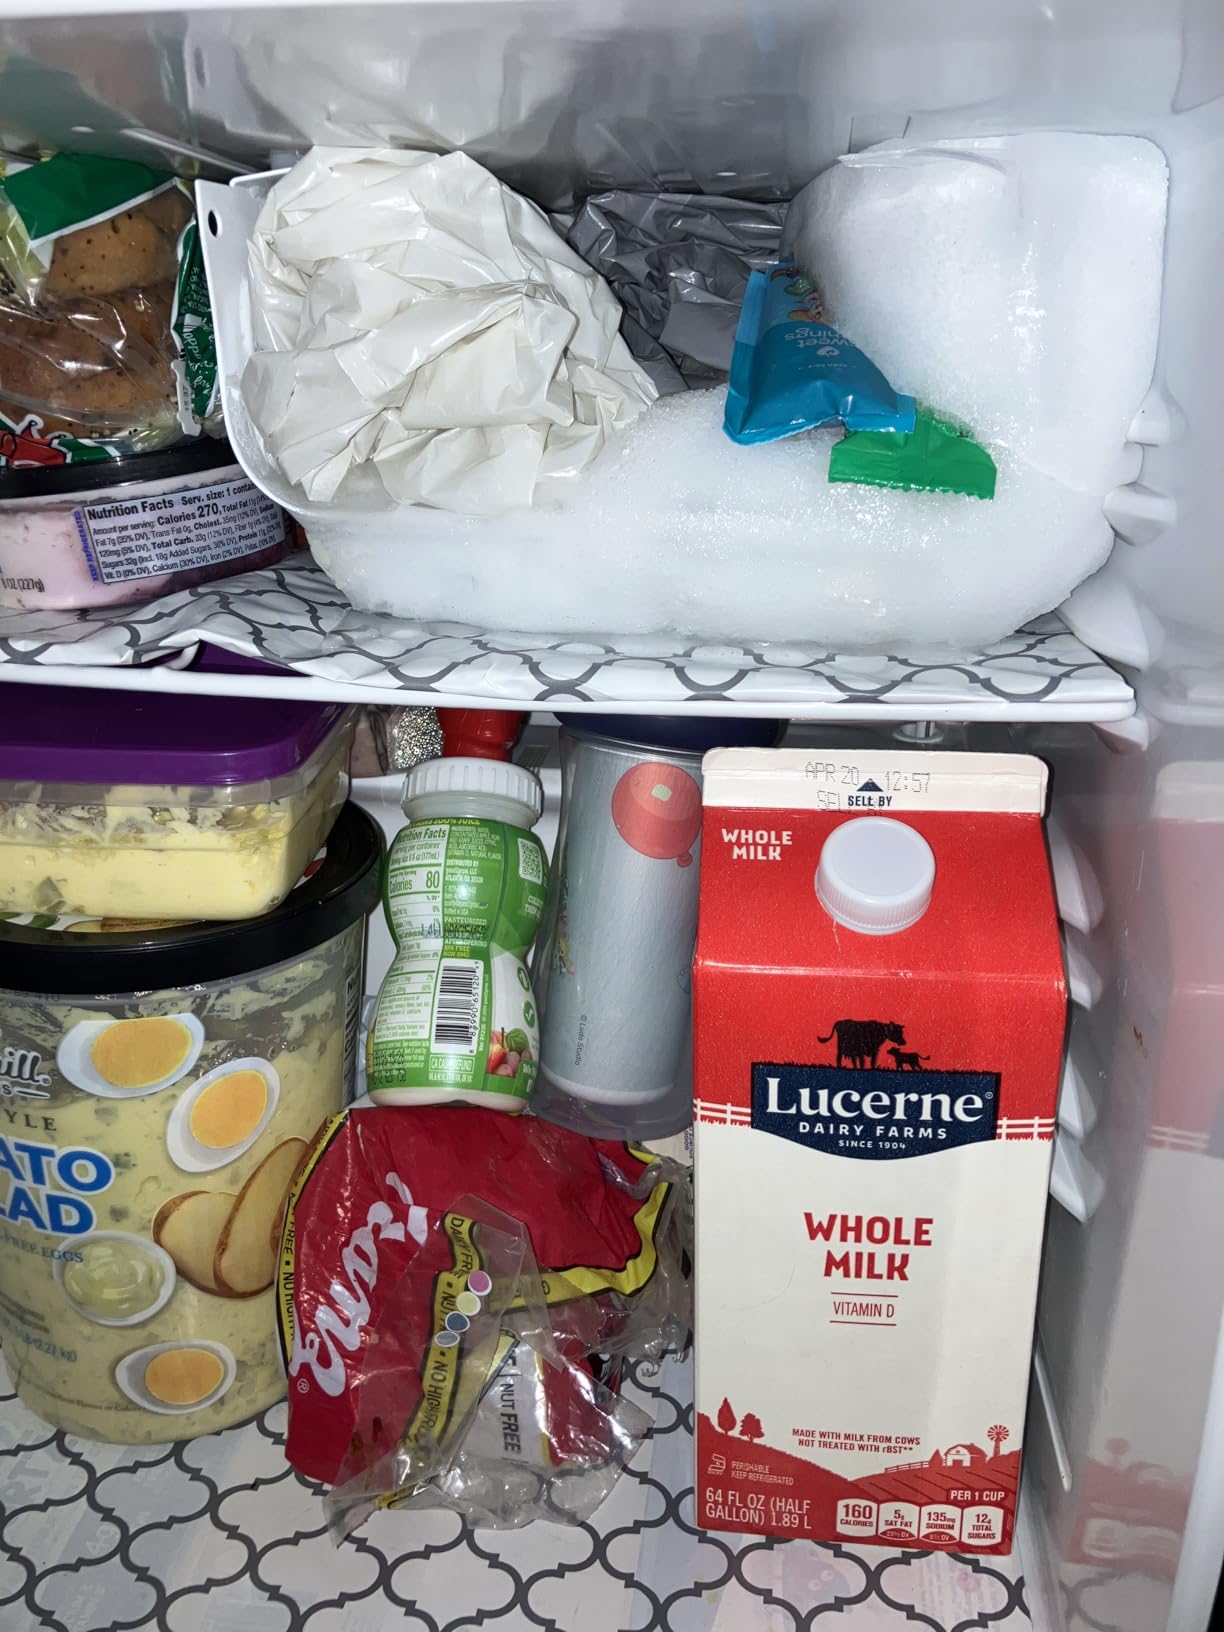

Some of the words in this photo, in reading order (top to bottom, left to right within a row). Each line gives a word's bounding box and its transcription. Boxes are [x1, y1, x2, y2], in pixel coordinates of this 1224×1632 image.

[784, 326, 840, 341] hings
[797, 338, 849, 348] weet
[87, 504, 138, 521] Nutrition
[141, 498, 174, 513] Facts
[181, 495, 204, 506] Serv.
[206, 489, 225, 501] size:
[226, 487, 231, 497] 1
[93, 525, 117, 536] Amount
[118, 525, 129, 534] per
[157, 511, 196, 526] Calories
[197, 502, 222, 518] 270,
[222, 502, 238, 513] Total
[239, 499, 248, 508] Fat
[73, 510, 94, 562] REFRIGERATED
[95, 538, 107, 547] Fat
[151, 529, 170, 539] Trans
[171, 526, 182, 535] Fat
[194, 518, 222, 531] Cholest.
[101, 559, 124, 570] Sugars
[169, 547, 189, 558] Added
[238, 531, 258, 542] Protein
[151, 540, 172, 550] Total
[173, 535, 194, 546] Carb.
[116, 570, 122, 578] D
[152, 561, 179, 573] Calcium
[210, 551, 222, 561] Iron
[805, 761, 836, 782] APR
[840, 765, 860, 786] 20
[884, 770, 931, 793] 12:57
[848, 795, 873, 807] SELL
[878, 795, 893, 807] BY
[424, 827, 447, 840] Facts
[721, 828, 793, 846] WHOLE
[732, 845, 782, 861] MILK
[426, 870, 441, 889] 80
[766, 1077, 983, 1123] Lucerne
[799, 1121, 865, 1136] DAIRY
[876, 1125, 948, 1140] FARMS
[838, 1139, 873, 1149] SINCE
[878, 1141, 907, 1150] 1904
[803, 1212, 934, 1246] WHOLE
[42, 1247, 84, 1263] EGGS
[824, 1249, 910, 1281] MILK
[833, 1301, 882, 1317] VITAMIN
[886, 1304, 895, 1318] D
[431, 1360, 448, 1384] NO
[500, 1382, 516, 1410] NUT
[501, 1411, 522, 1455] FREE
[792, 1428, 816, 1438] MADE
[819, 1430, 841, 1440] WITH
[844, 1432, 864, 1442] MILK
[867, 1434, 892, 1444] FROM
[895, 1436, 921, 1445] COWS
[798, 1438, 815, 1448] NOT
[818, 1440, 855, 1451] TREATED
[857, 1443, 880, 1453] WITH
[731, 1460, 770, 1474] PERISHABLE
[731, 1470, 747, 1480] KEEP
[748, 1472, 794, 1486] REFRIGERATED
[706, 1487, 723, 1504] 64
[728, 1490, 743, 1507] FL
[747, 1493, 765, 1510] OZ
[770, 1496, 811, 1514] (HALF
[950, 1490, 971, 1501] PER
[975, 1491, 979, 1501] 1
[983, 1491, 1005, 1502] CUP
[706, 1502, 765, 1526] GALLON)
[770, 1511, 799, 1528] 1.89
[804, 1515, 812, 1529] L
[842, 1503, 872, 1520] 160
[839, 1518, 873, 1528] CALORIES
[884, 1519, 899, 1527] SAT
[900, 1520, 913, 1528] FAT
[926, 1522, 955, 1531] SODIUM
[971, 1524, 992, 1532] TOTAL
[967, 1531, 996, 1540] SUGARS
